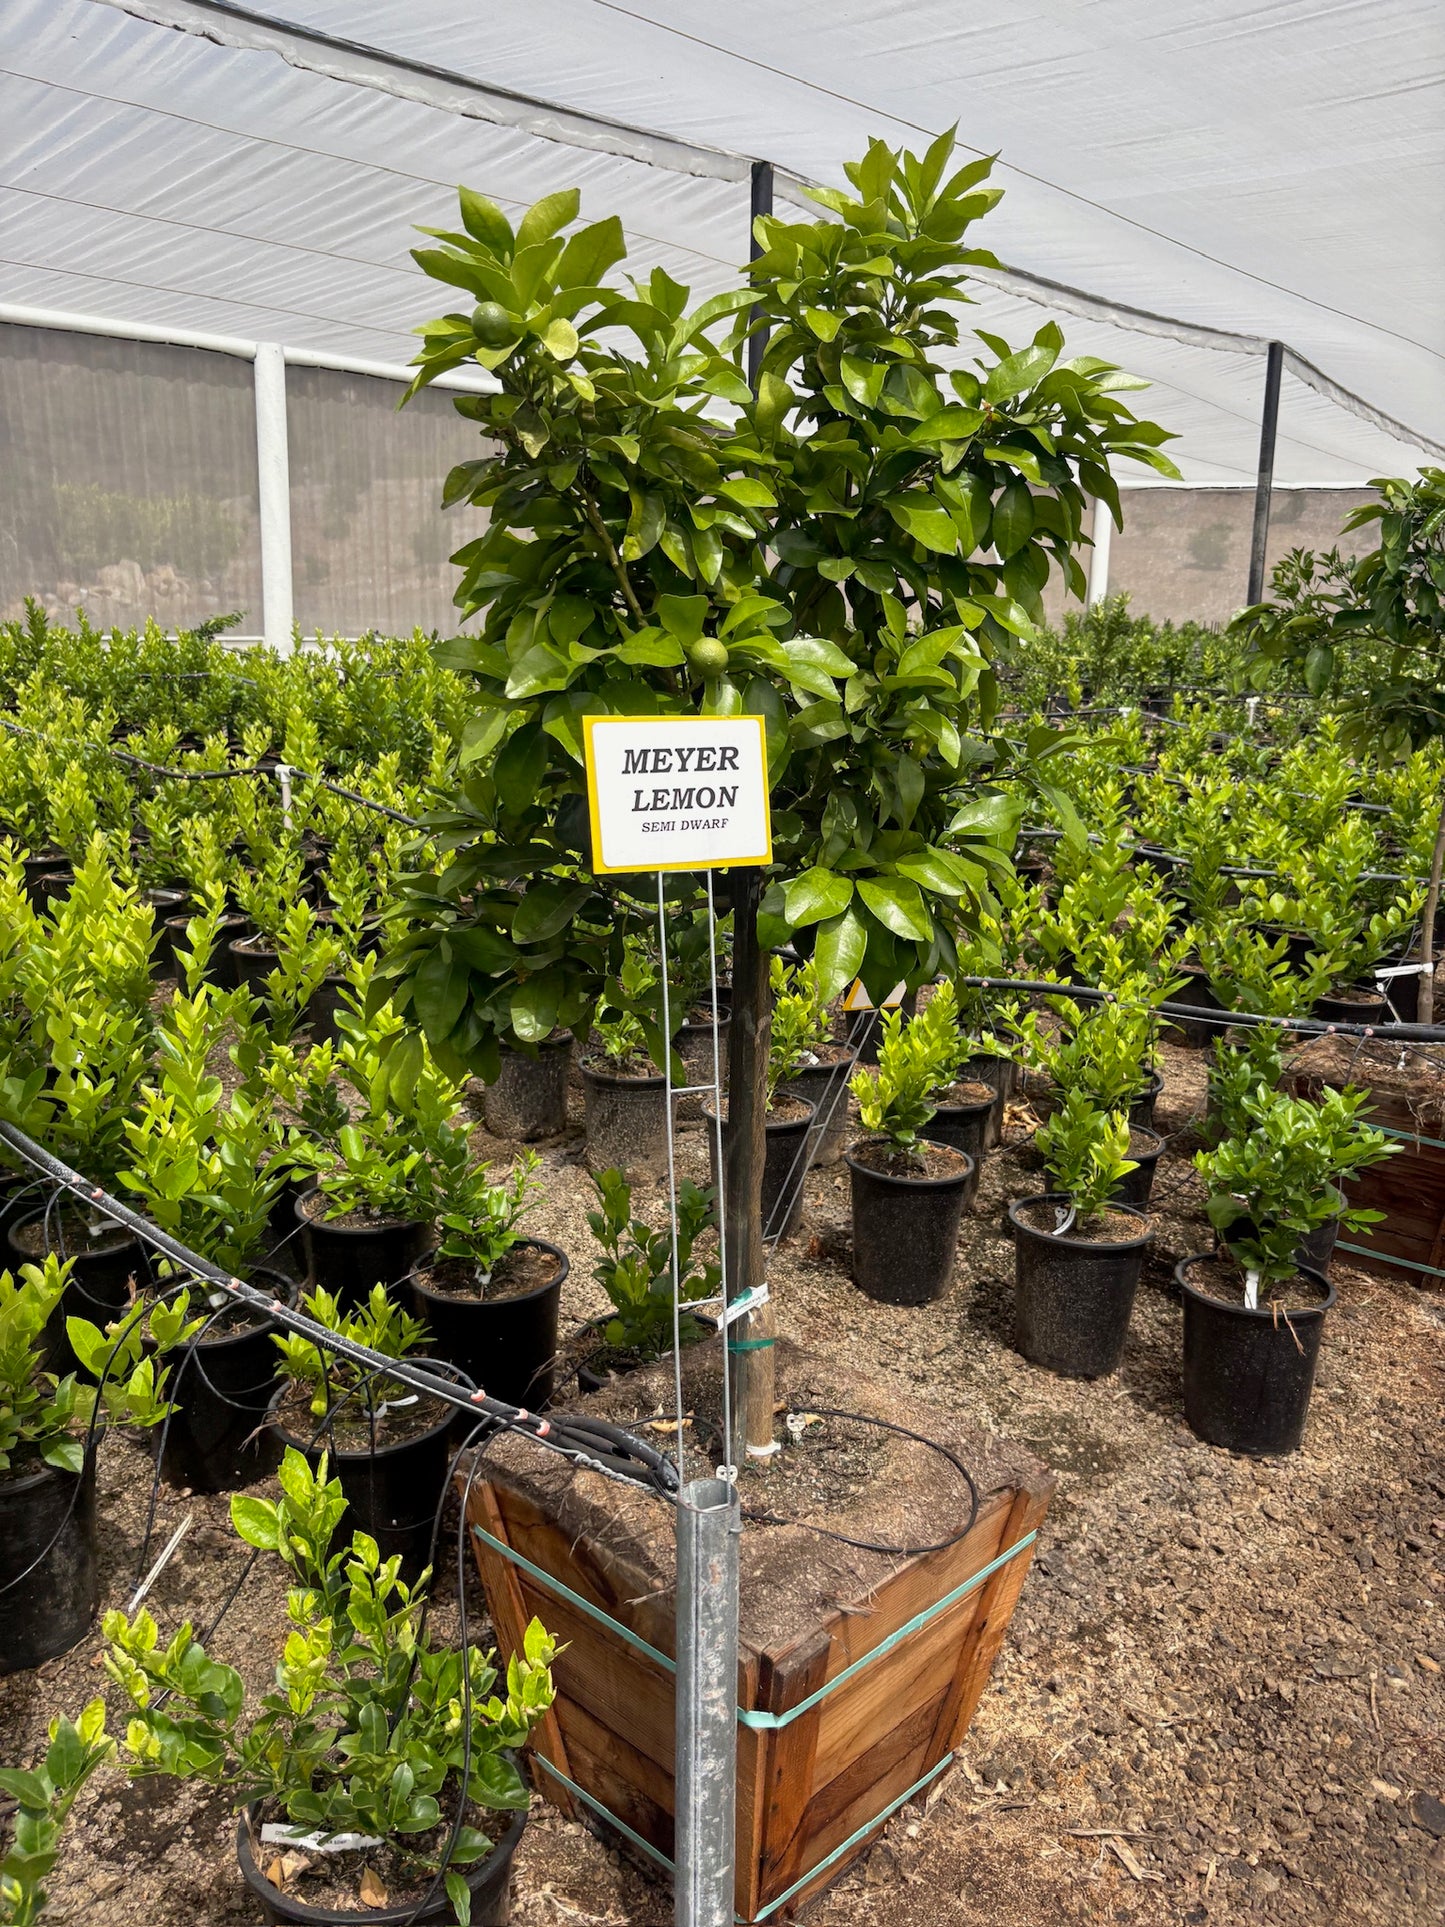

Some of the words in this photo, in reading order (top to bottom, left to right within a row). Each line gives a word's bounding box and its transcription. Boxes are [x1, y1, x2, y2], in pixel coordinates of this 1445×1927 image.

[622, 746, 739, 775] MEYER
[631, 786, 739, 812] LEMON
[641, 820, 676, 833] SEMI
[680, 818, 729, 831] DWARF
